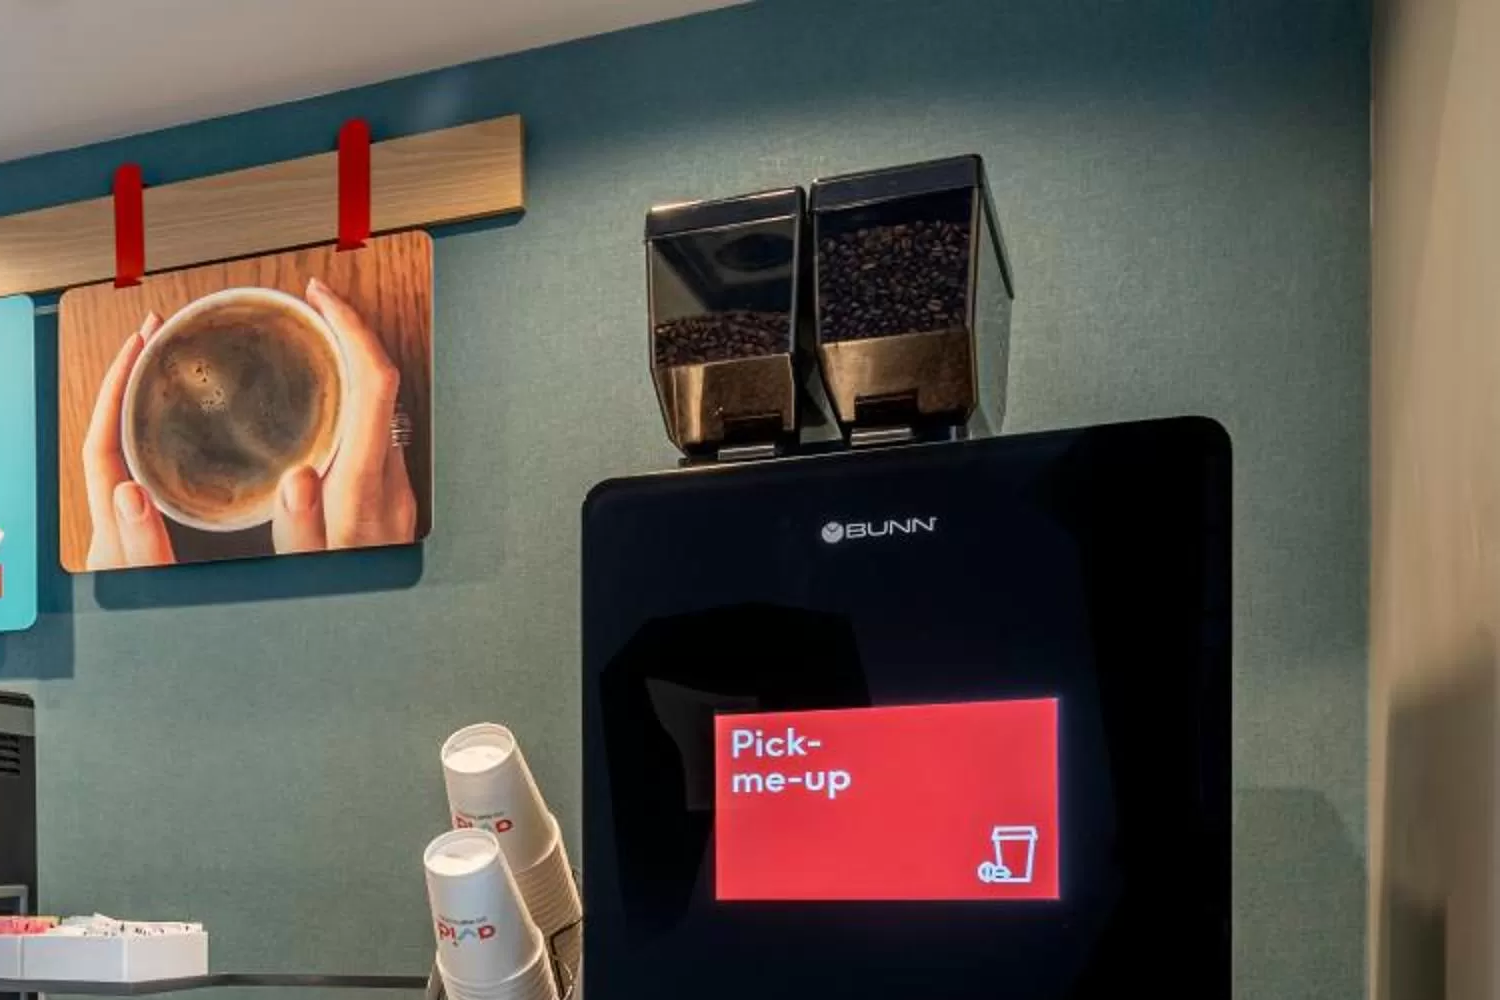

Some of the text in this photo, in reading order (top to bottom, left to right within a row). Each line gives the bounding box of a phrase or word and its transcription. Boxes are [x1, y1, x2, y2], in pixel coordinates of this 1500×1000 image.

[845, 516, 938, 539] BUNN
[732, 727, 821, 759] Pick-
[732, 769, 851, 800] me-up
